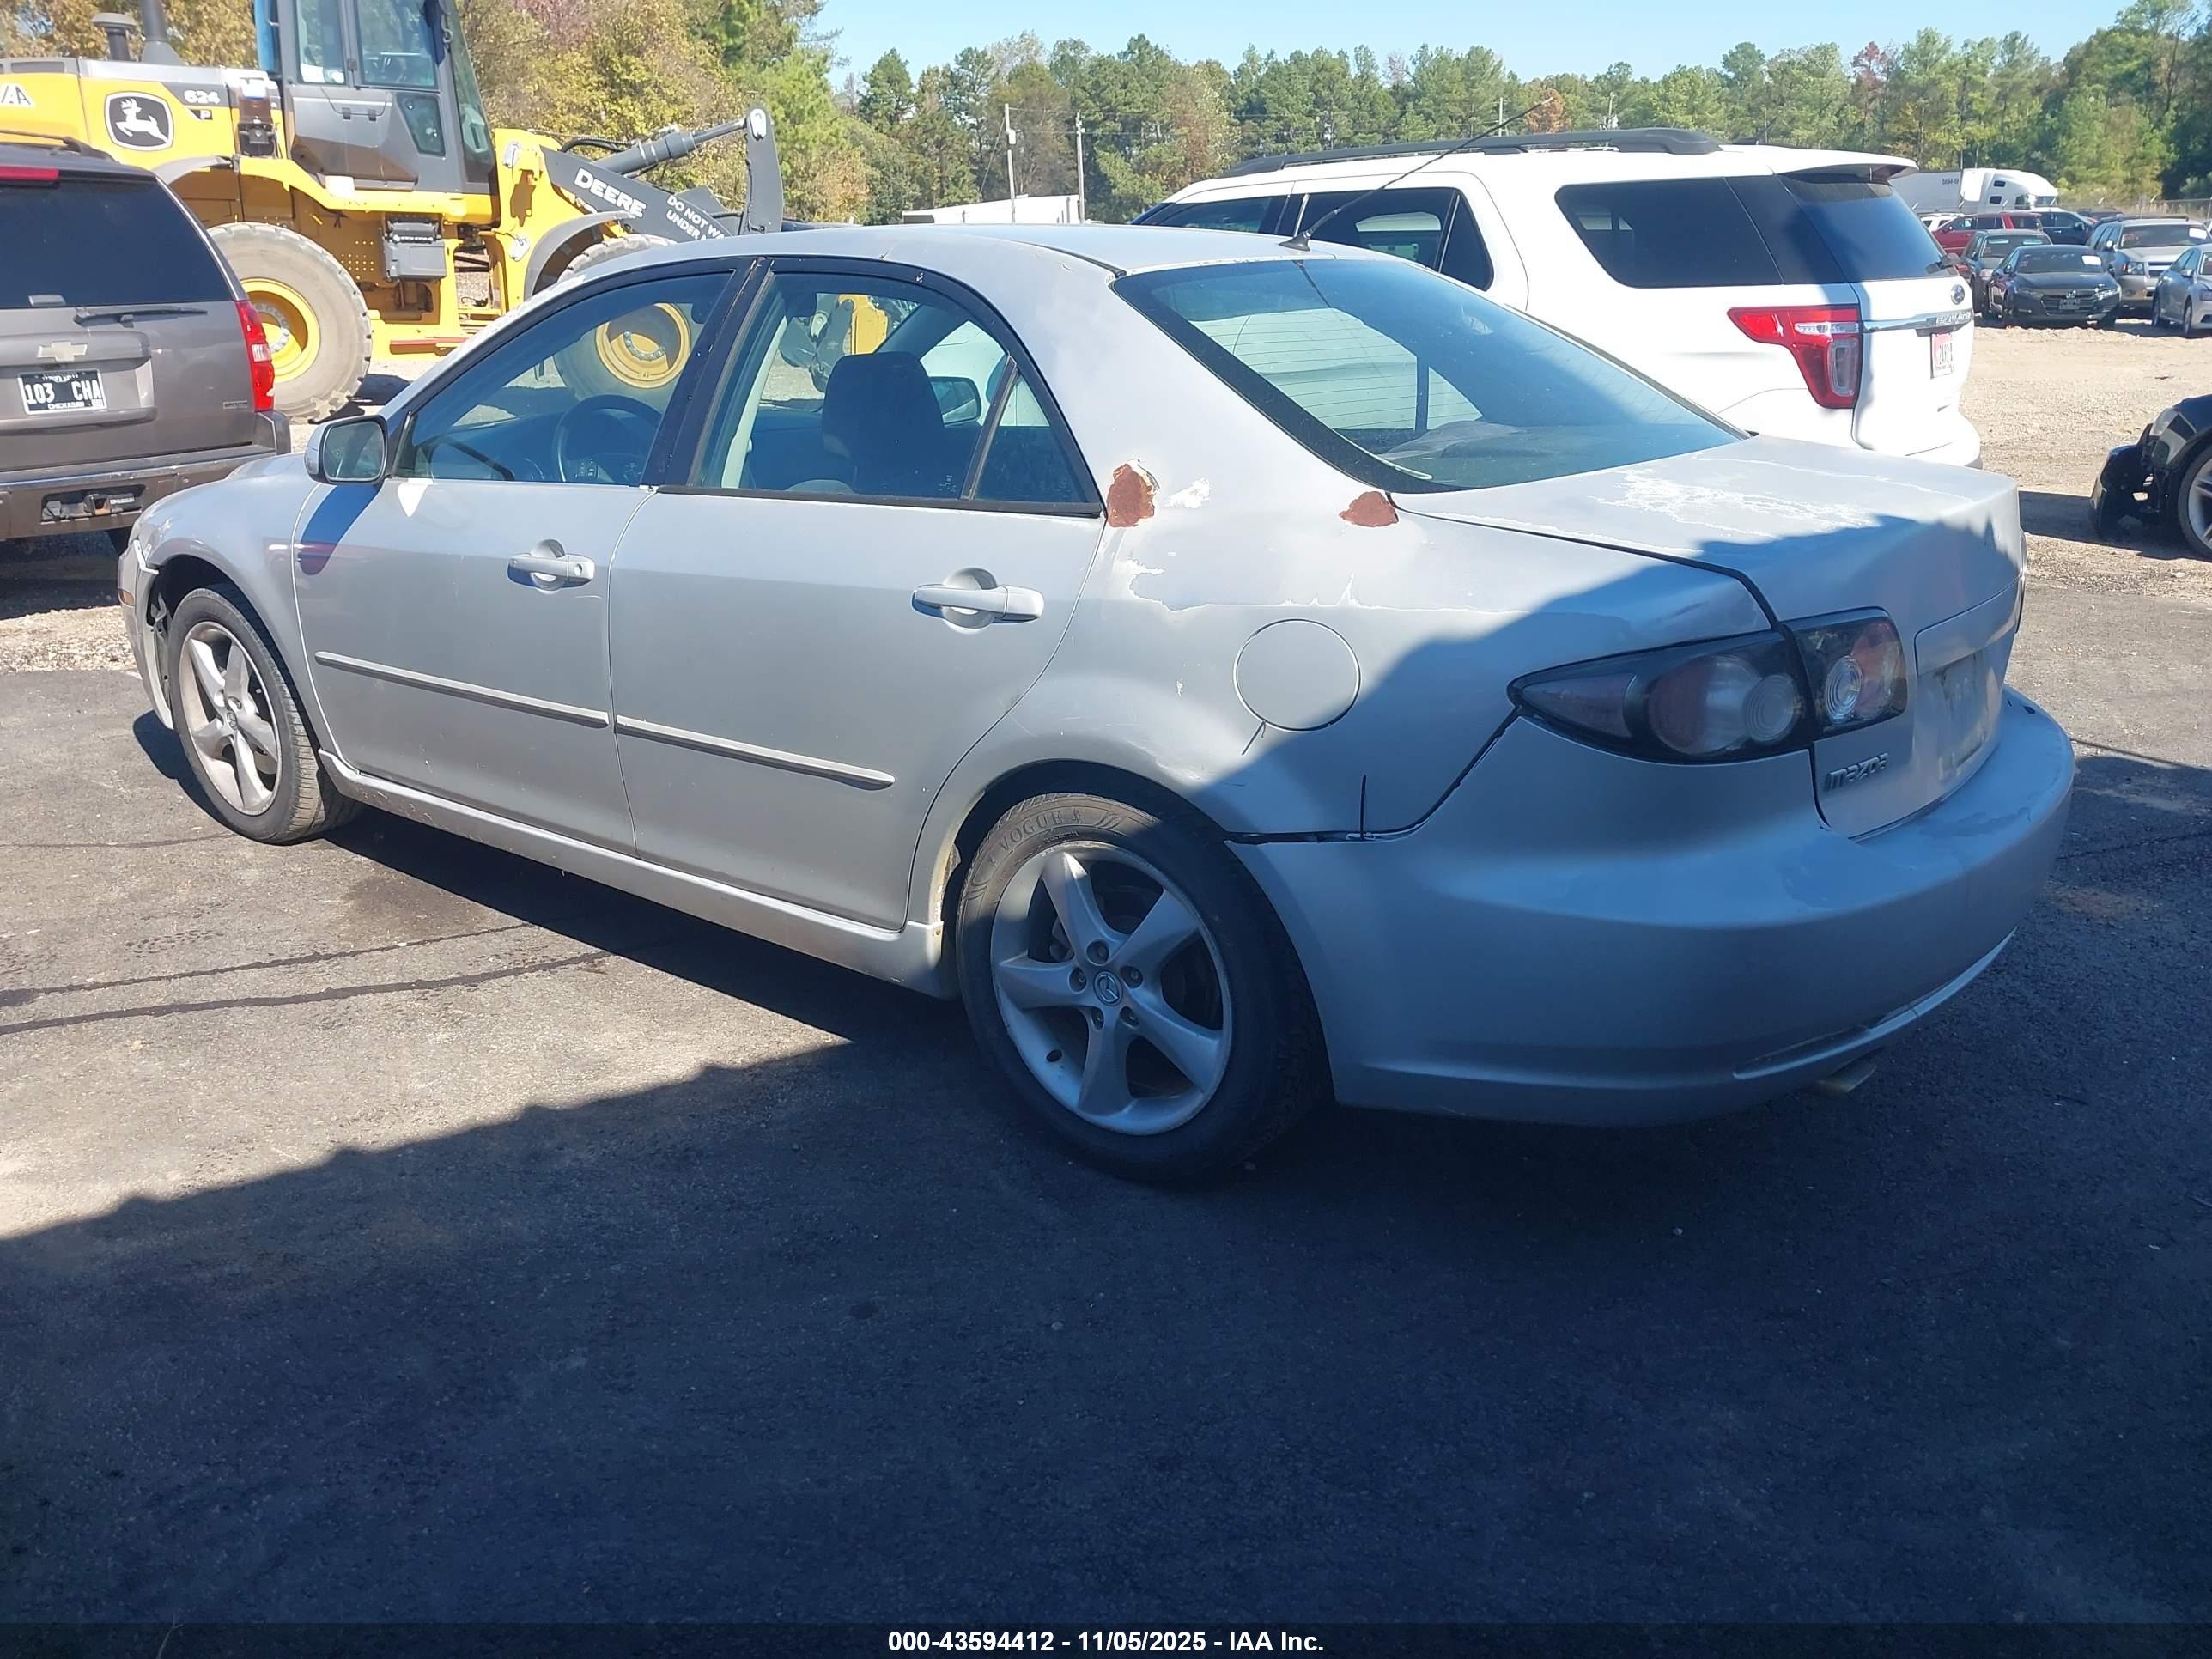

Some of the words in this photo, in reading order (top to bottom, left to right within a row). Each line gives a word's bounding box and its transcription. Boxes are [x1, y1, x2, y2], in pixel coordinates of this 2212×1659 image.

[574, 167, 647, 218] DEERE
[666, 209, 701, 240] UNDER
[667, 195, 684, 212] DO
[684, 207, 708, 228] NOT
[71, 380, 102, 401] CHA
[998, 810, 1063, 851] VOGUE
